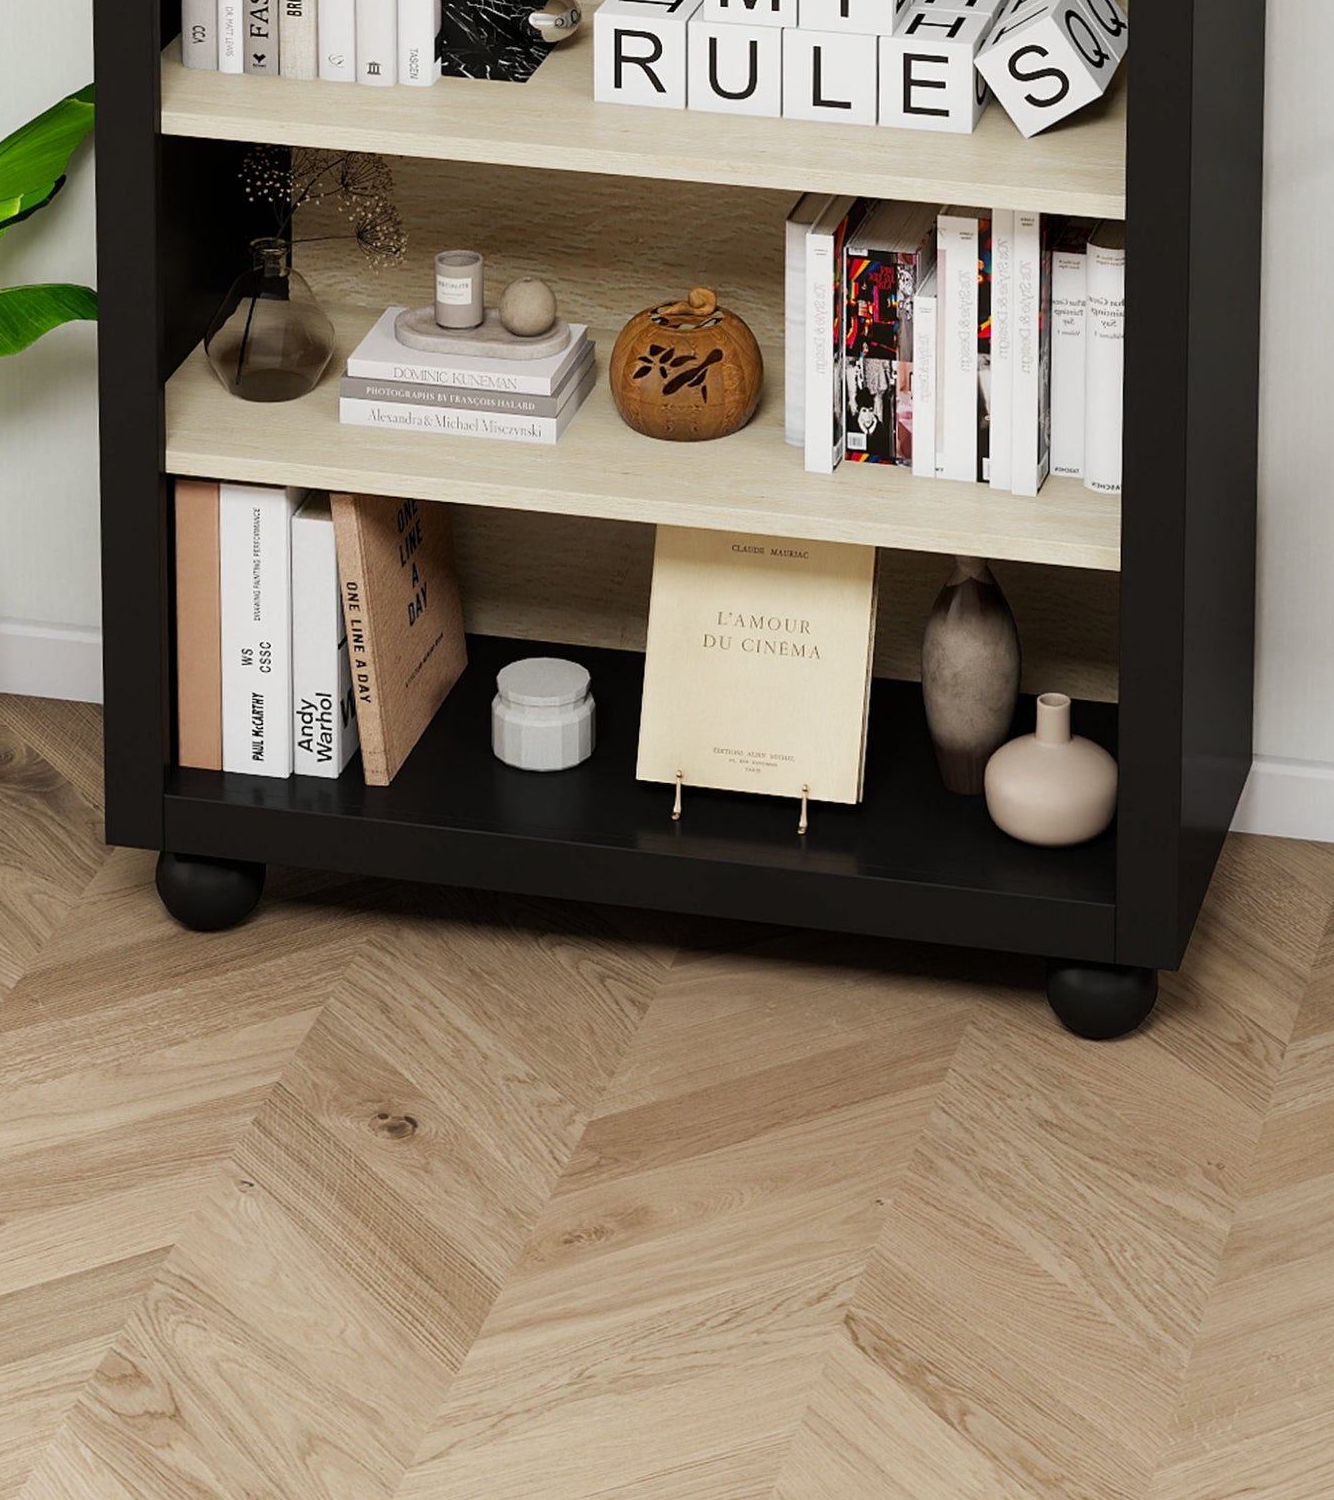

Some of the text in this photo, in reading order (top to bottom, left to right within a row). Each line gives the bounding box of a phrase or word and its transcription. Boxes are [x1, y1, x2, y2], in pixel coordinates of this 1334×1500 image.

[192, 25, 205, 44] CCA
[614, 28, 1070, 117] RULES
[393, 367, 517, 390] DOMINIC KUNEMAN
[366, 387, 536, 411] PHOTOGRAPHS BY FRANÇOIS HALARD
[367, 408, 542, 438] Alexandra & Michael Misczynski
[399, 518, 423, 567] LINE
[731, 544, 809, 559] CLAUDE MAURIAC
[412, 562, 419, 588] A
[408, 581, 428, 627] DAY
[717, 611, 811, 635] L'AMOUR
[241, 648, 254, 666] WS
[259, 641, 272, 673] CSSC
[346, 581, 371, 703] ONE LINE A DAY
[702, 634, 732, 651] DU
[251, 692, 264, 761] PAUL McCARTHY
[296, 699, 318, 752] Andy
[315, 692, 332, 762] Warhol
